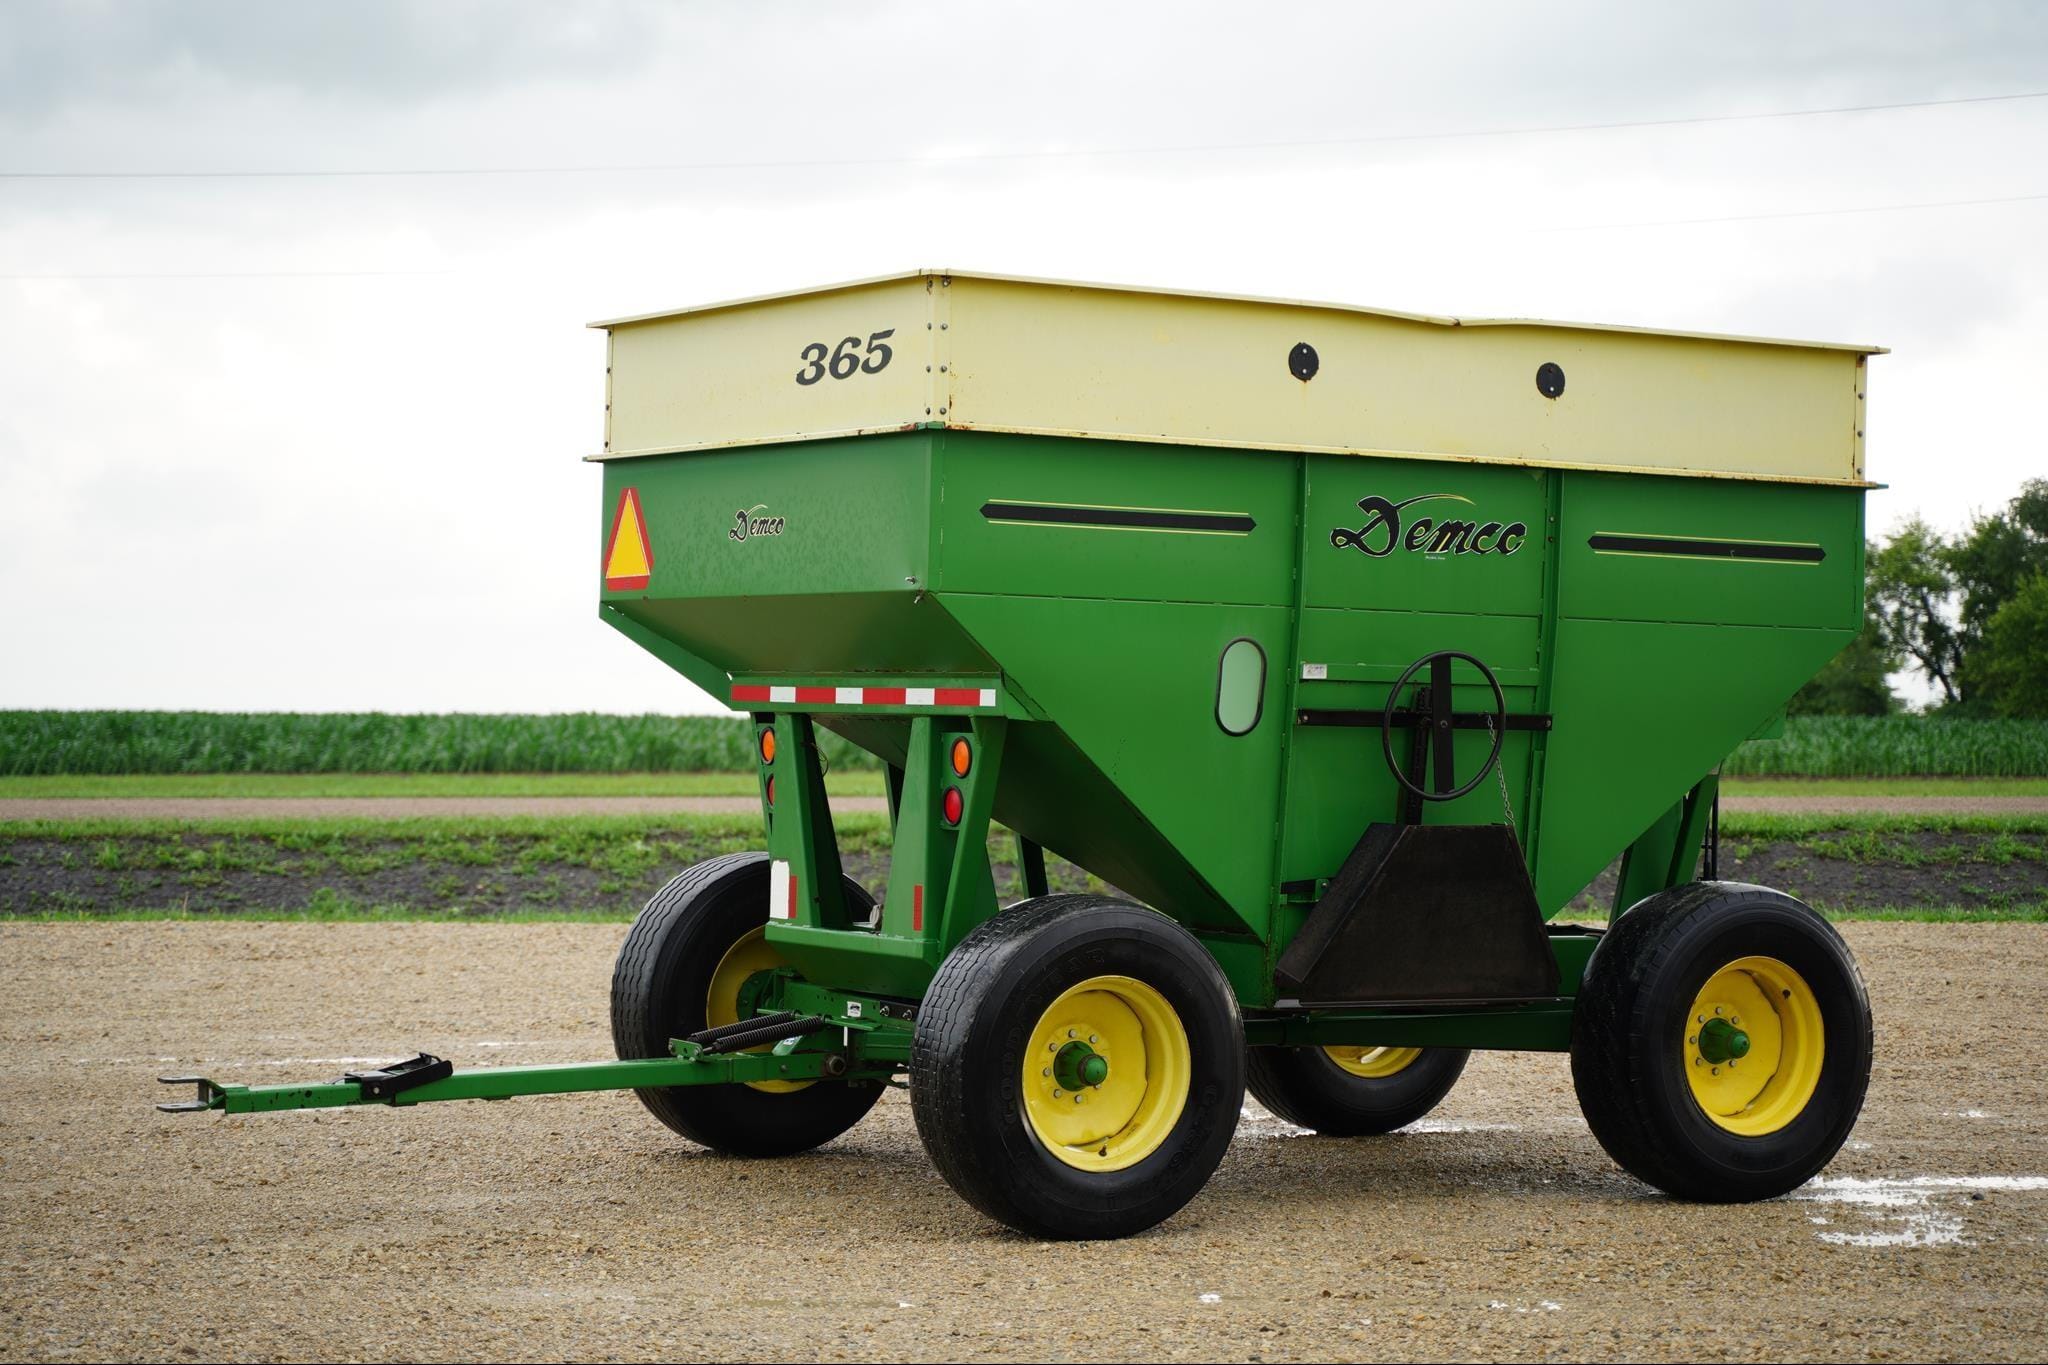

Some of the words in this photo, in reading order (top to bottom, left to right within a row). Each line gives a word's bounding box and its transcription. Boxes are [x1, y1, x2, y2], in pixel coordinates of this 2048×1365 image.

[796, 328, 896, 386] 365
[728, 504, 785, 542] Demco
[1330, 494, 1527, 558] Demco
